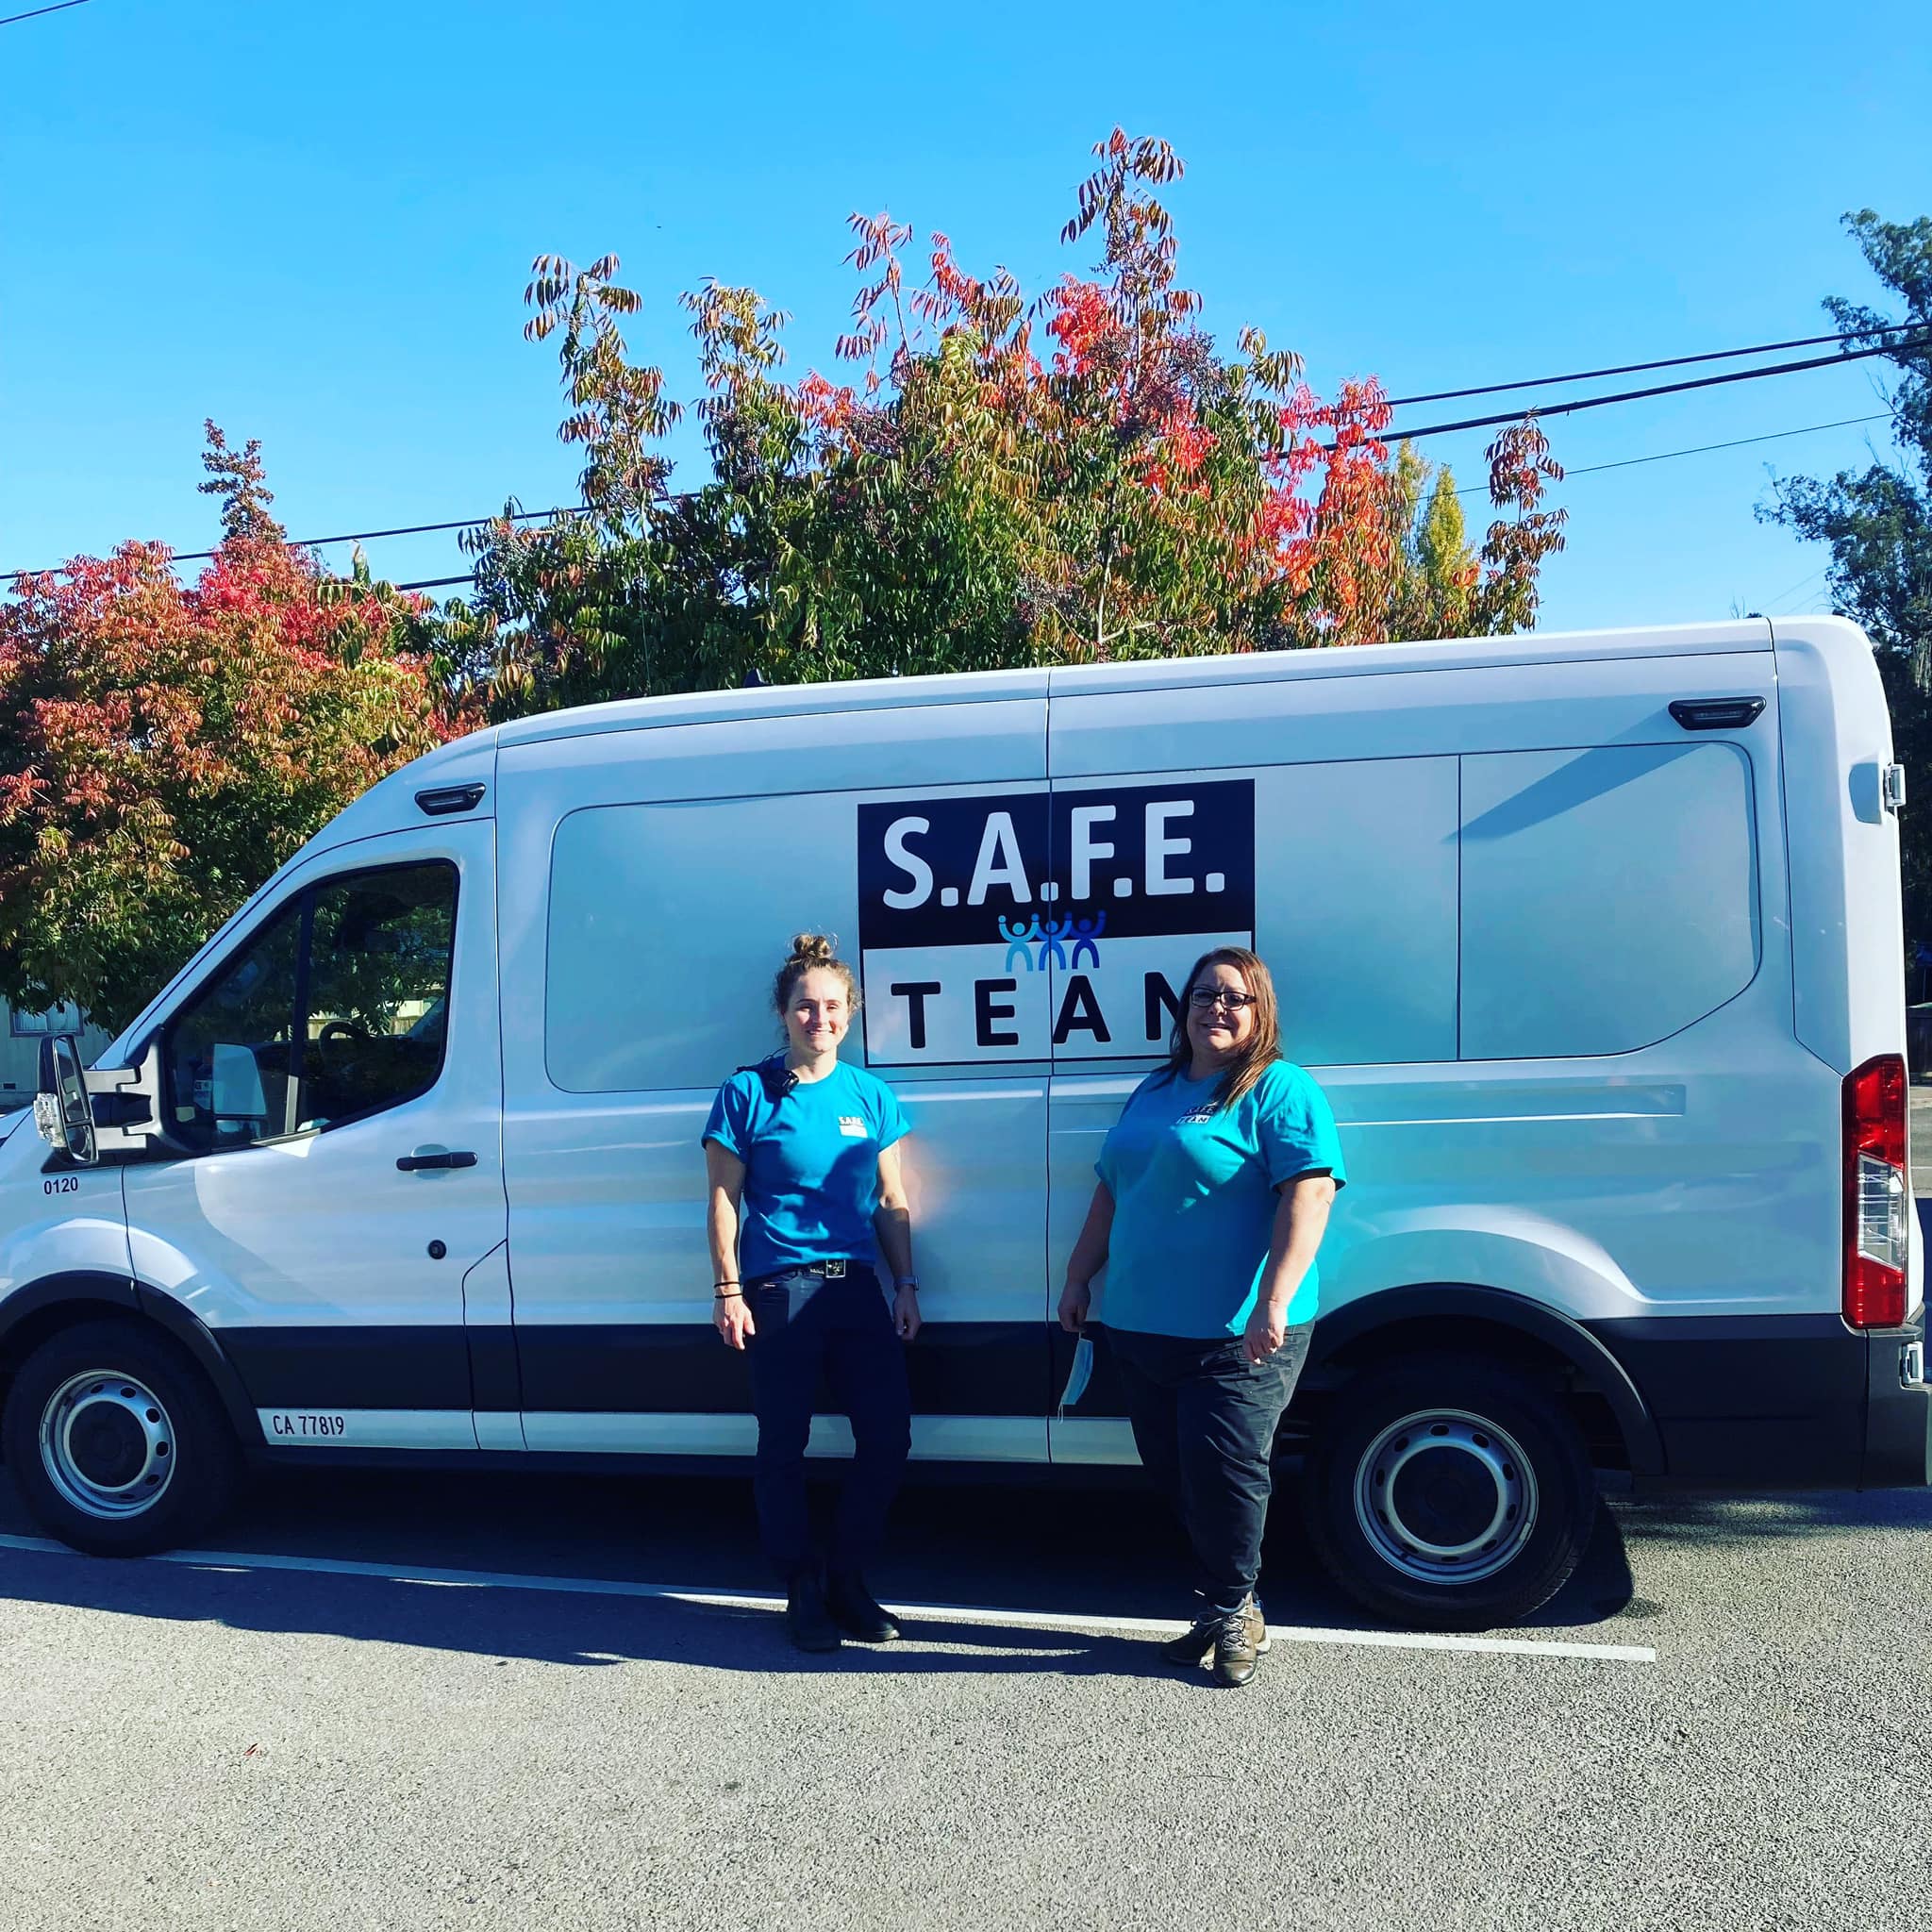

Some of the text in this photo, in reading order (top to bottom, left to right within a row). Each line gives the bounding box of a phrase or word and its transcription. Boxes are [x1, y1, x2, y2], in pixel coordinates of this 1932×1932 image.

[882, 799, 1225, 910] S.A.F.E.
[43, 1176, 78, 1195] 0120
[273, 1415, 345, 1436] CA 77819
